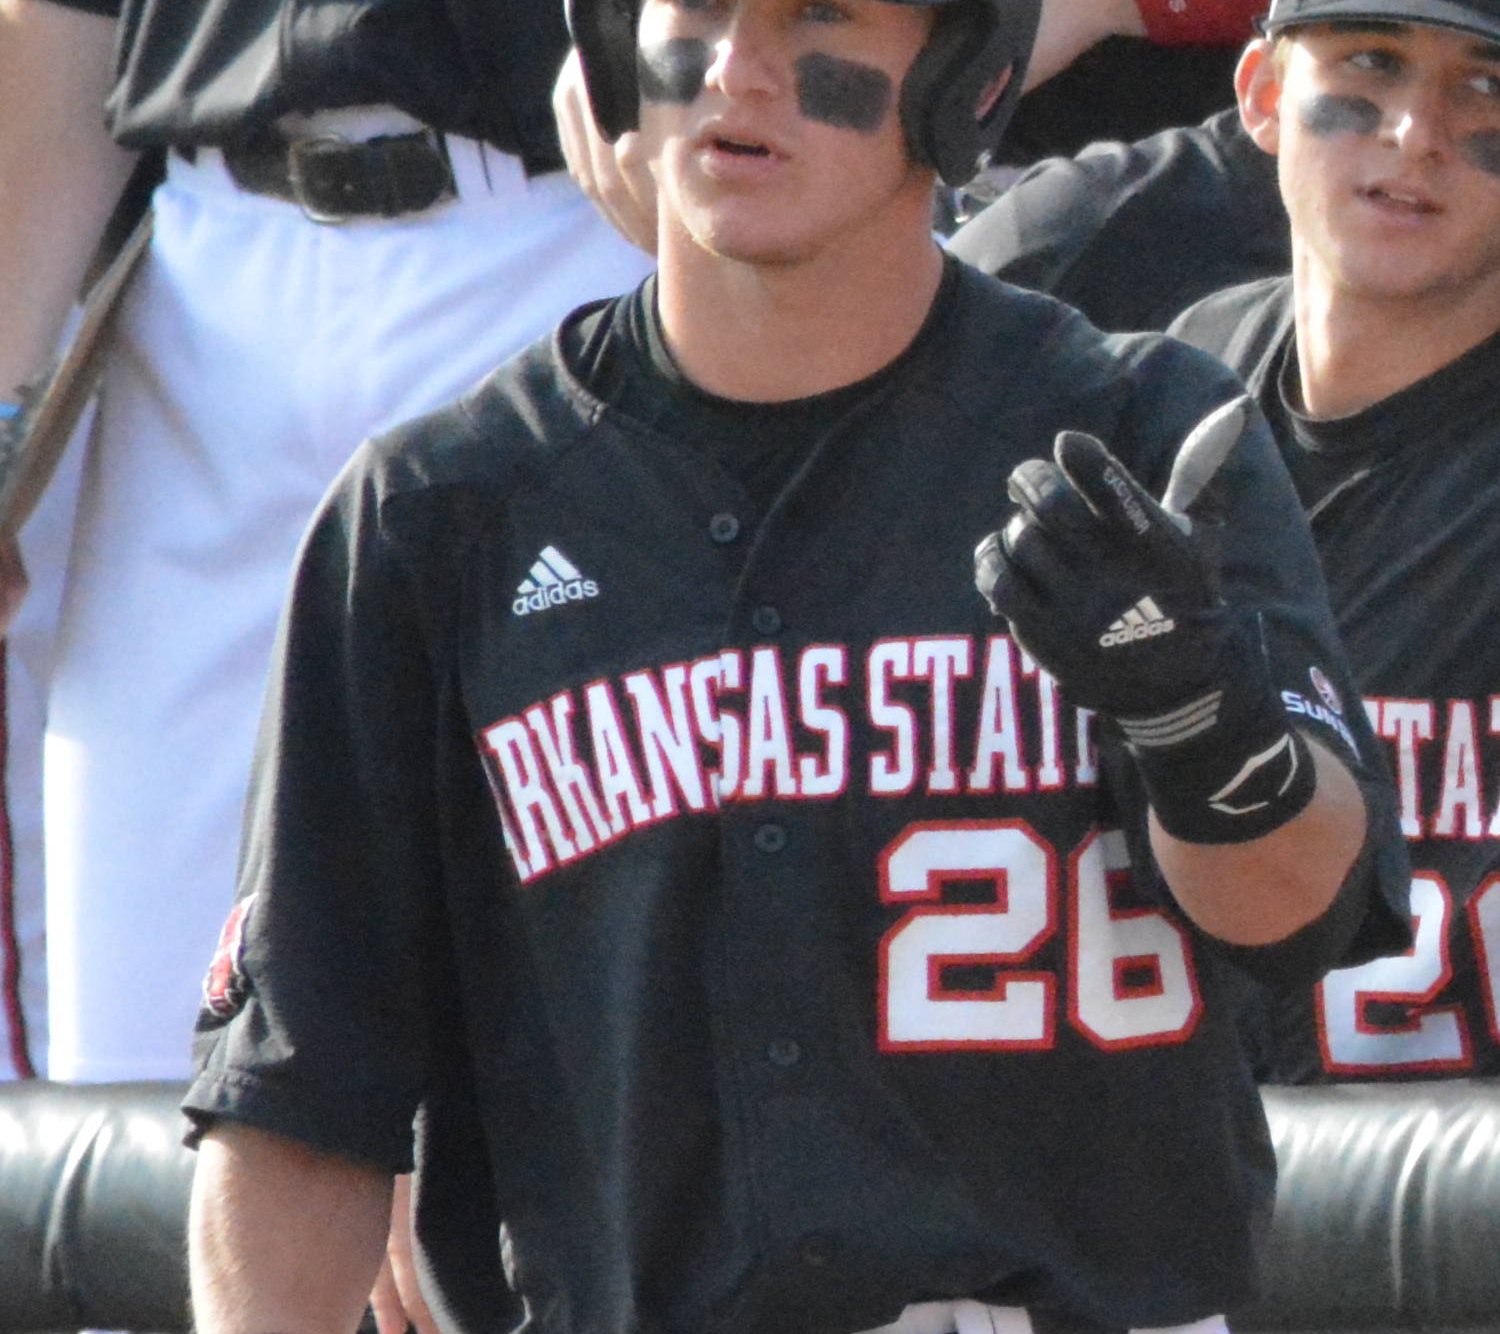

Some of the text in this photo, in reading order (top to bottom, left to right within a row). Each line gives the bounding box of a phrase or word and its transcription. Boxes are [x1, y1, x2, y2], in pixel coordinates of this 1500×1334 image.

[511, 576, 599, 617] adidas
[1100, 618, 1174, 648] adidas
[480, 643, 848, 887] RKANSAS
[877, 818, 1203, 1053] 26
